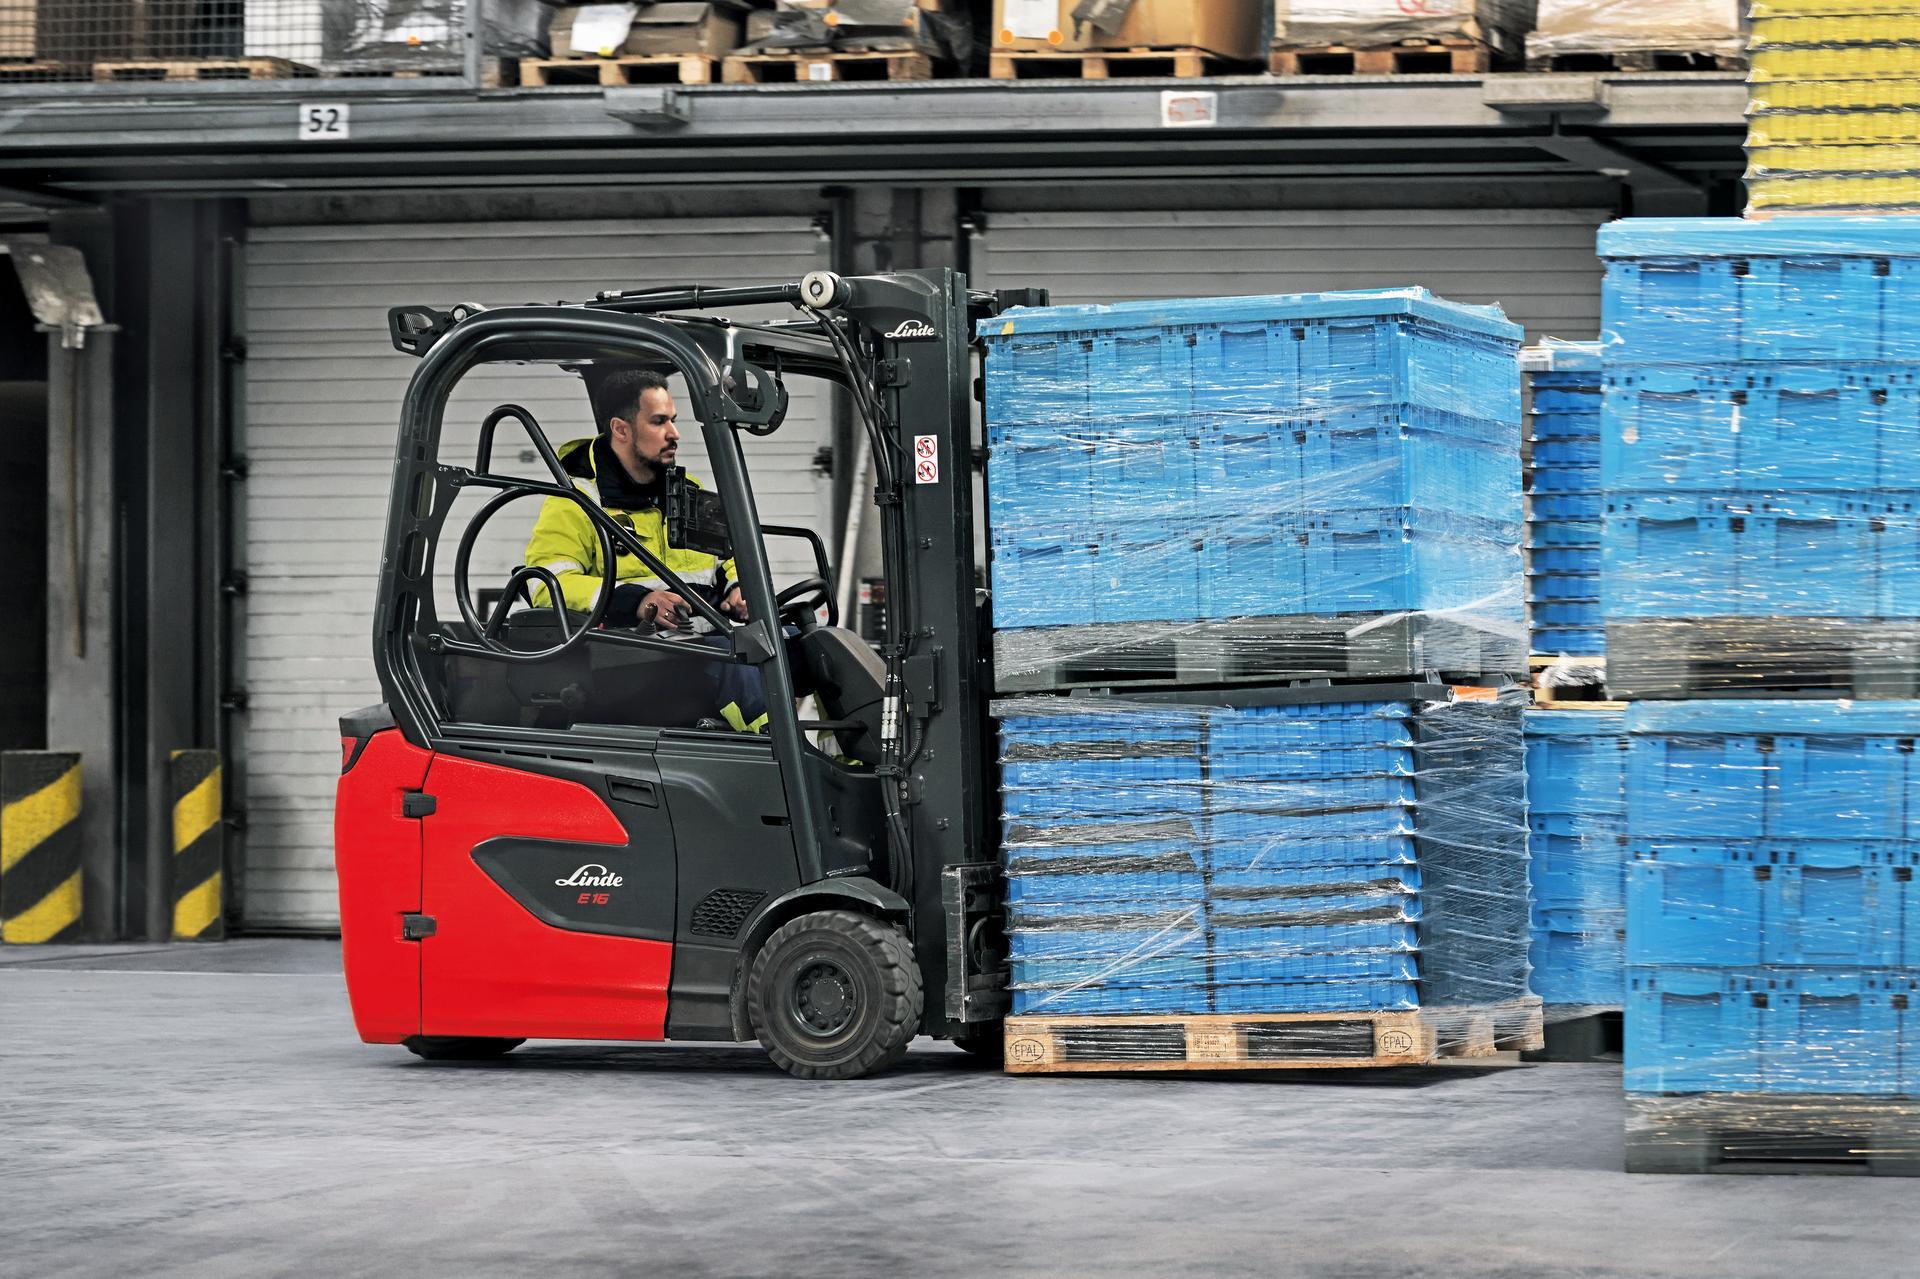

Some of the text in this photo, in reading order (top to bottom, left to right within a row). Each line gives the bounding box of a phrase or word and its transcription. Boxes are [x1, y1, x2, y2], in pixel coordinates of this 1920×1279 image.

[309, 109, 339, 132] 52
[884, 319, 935, 338] Linde
[554, 863, 623, 887] Linde
[1014, 1044, 1040, 1058] EPAL
[1383, 1036, 1408, 1049] EPAL
